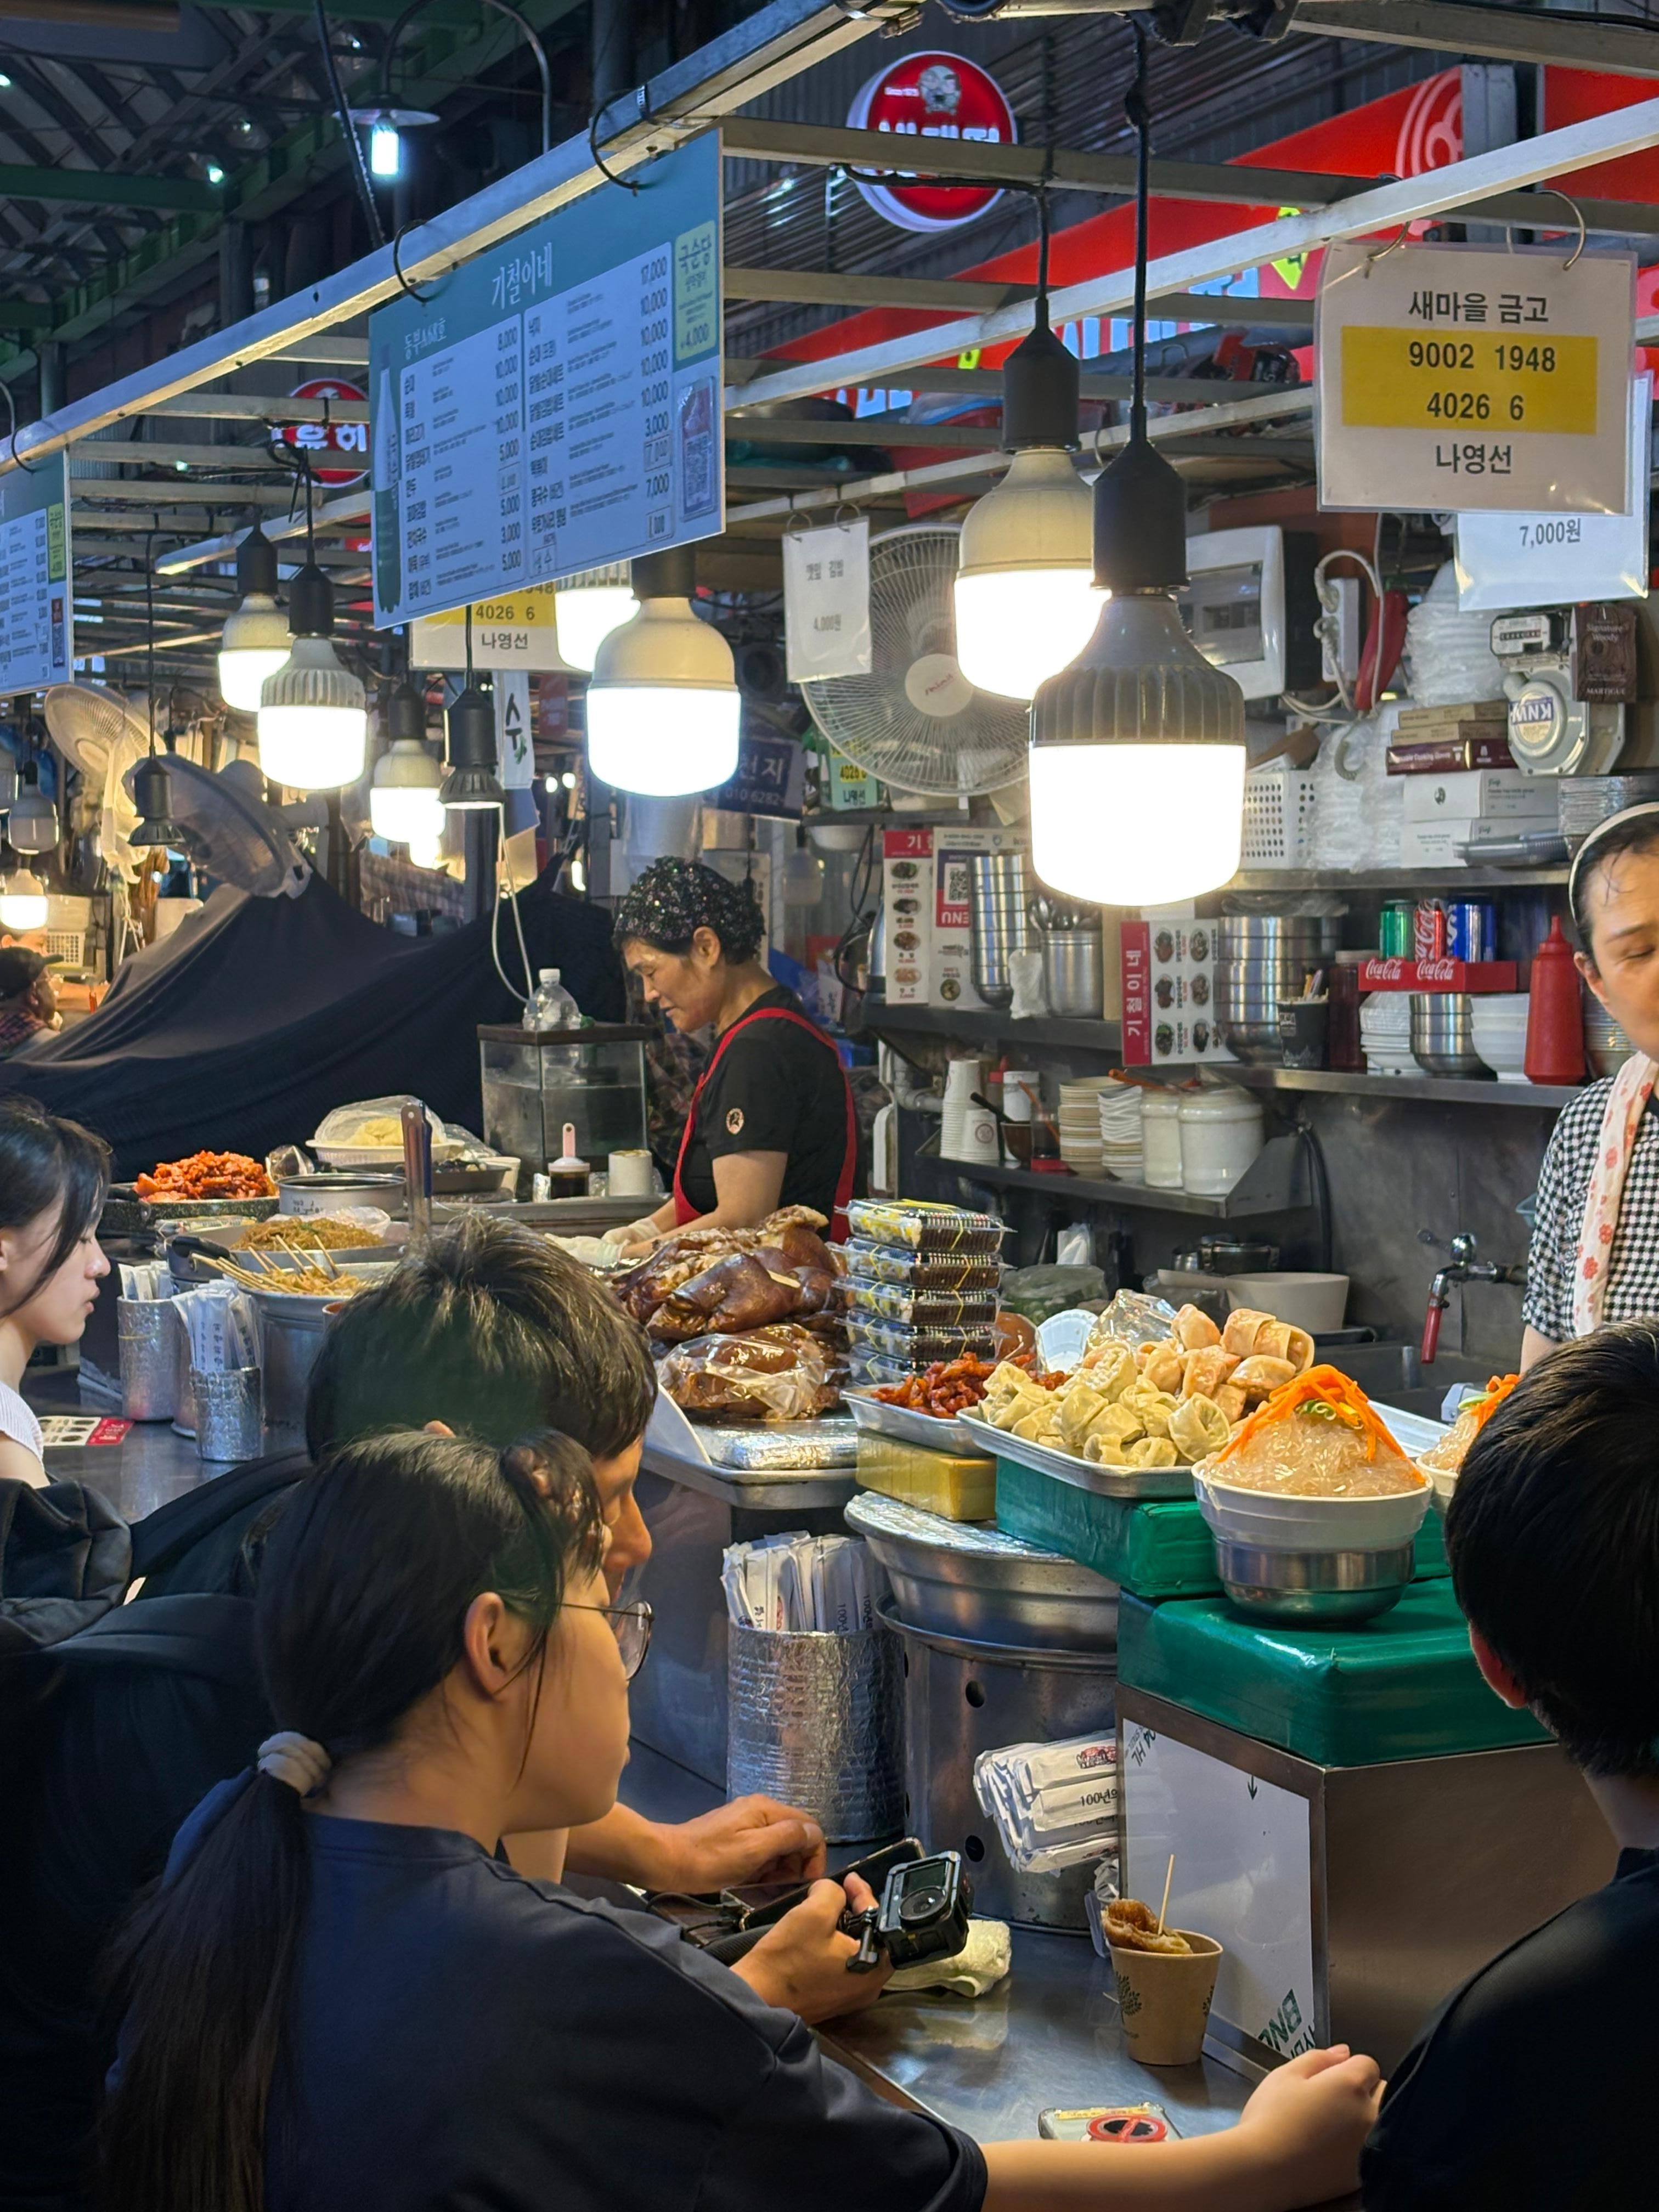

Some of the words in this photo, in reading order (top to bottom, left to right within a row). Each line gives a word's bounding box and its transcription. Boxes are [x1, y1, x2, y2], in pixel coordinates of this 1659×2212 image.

[491, 242, 552, 309] 기철이네
[641, 287, 668, 317] 10,000
[1408, 290, 1488, 323] 새마을
[1498, 293, 1549, 324] 금고
[641, 318, 668, 347] 10,000
[495, 354, 518, 379] 10,000
[529, 344, 541, 366] 순대
[641, 349, 668, 377] 10,000
[1409, 341, 1474, 370] 9002
[1494, 345, 1556, 373] 1948
[495, 382, 518, 407] 10,000
[641, 380, 669, 409] 10,000
[1426, 392, 1489, 419] 4026
[1510, 395, 1524, 420] 6
[496, 410, 518, 434] 10,000
[645, 411, 669, 438] 3,000
[499, 438, 519, 461] 5,000
[1436, 443, 1513, 474] 나영선
[646, 472, 669, 498] 7,000
[501, 494, 520, 516] 5,000
[501, 522, 520, 544] 3,000
[1519, 517, 1581, 546] 7,000원
[502, 549, 521, 571] 5,000
[476, 605, 514, 620] 4026
[526, 606, 535, 620] 6
[482, 633, 528, 650] 나영선
[1126, 950, 1143, 1037] 기철이네
